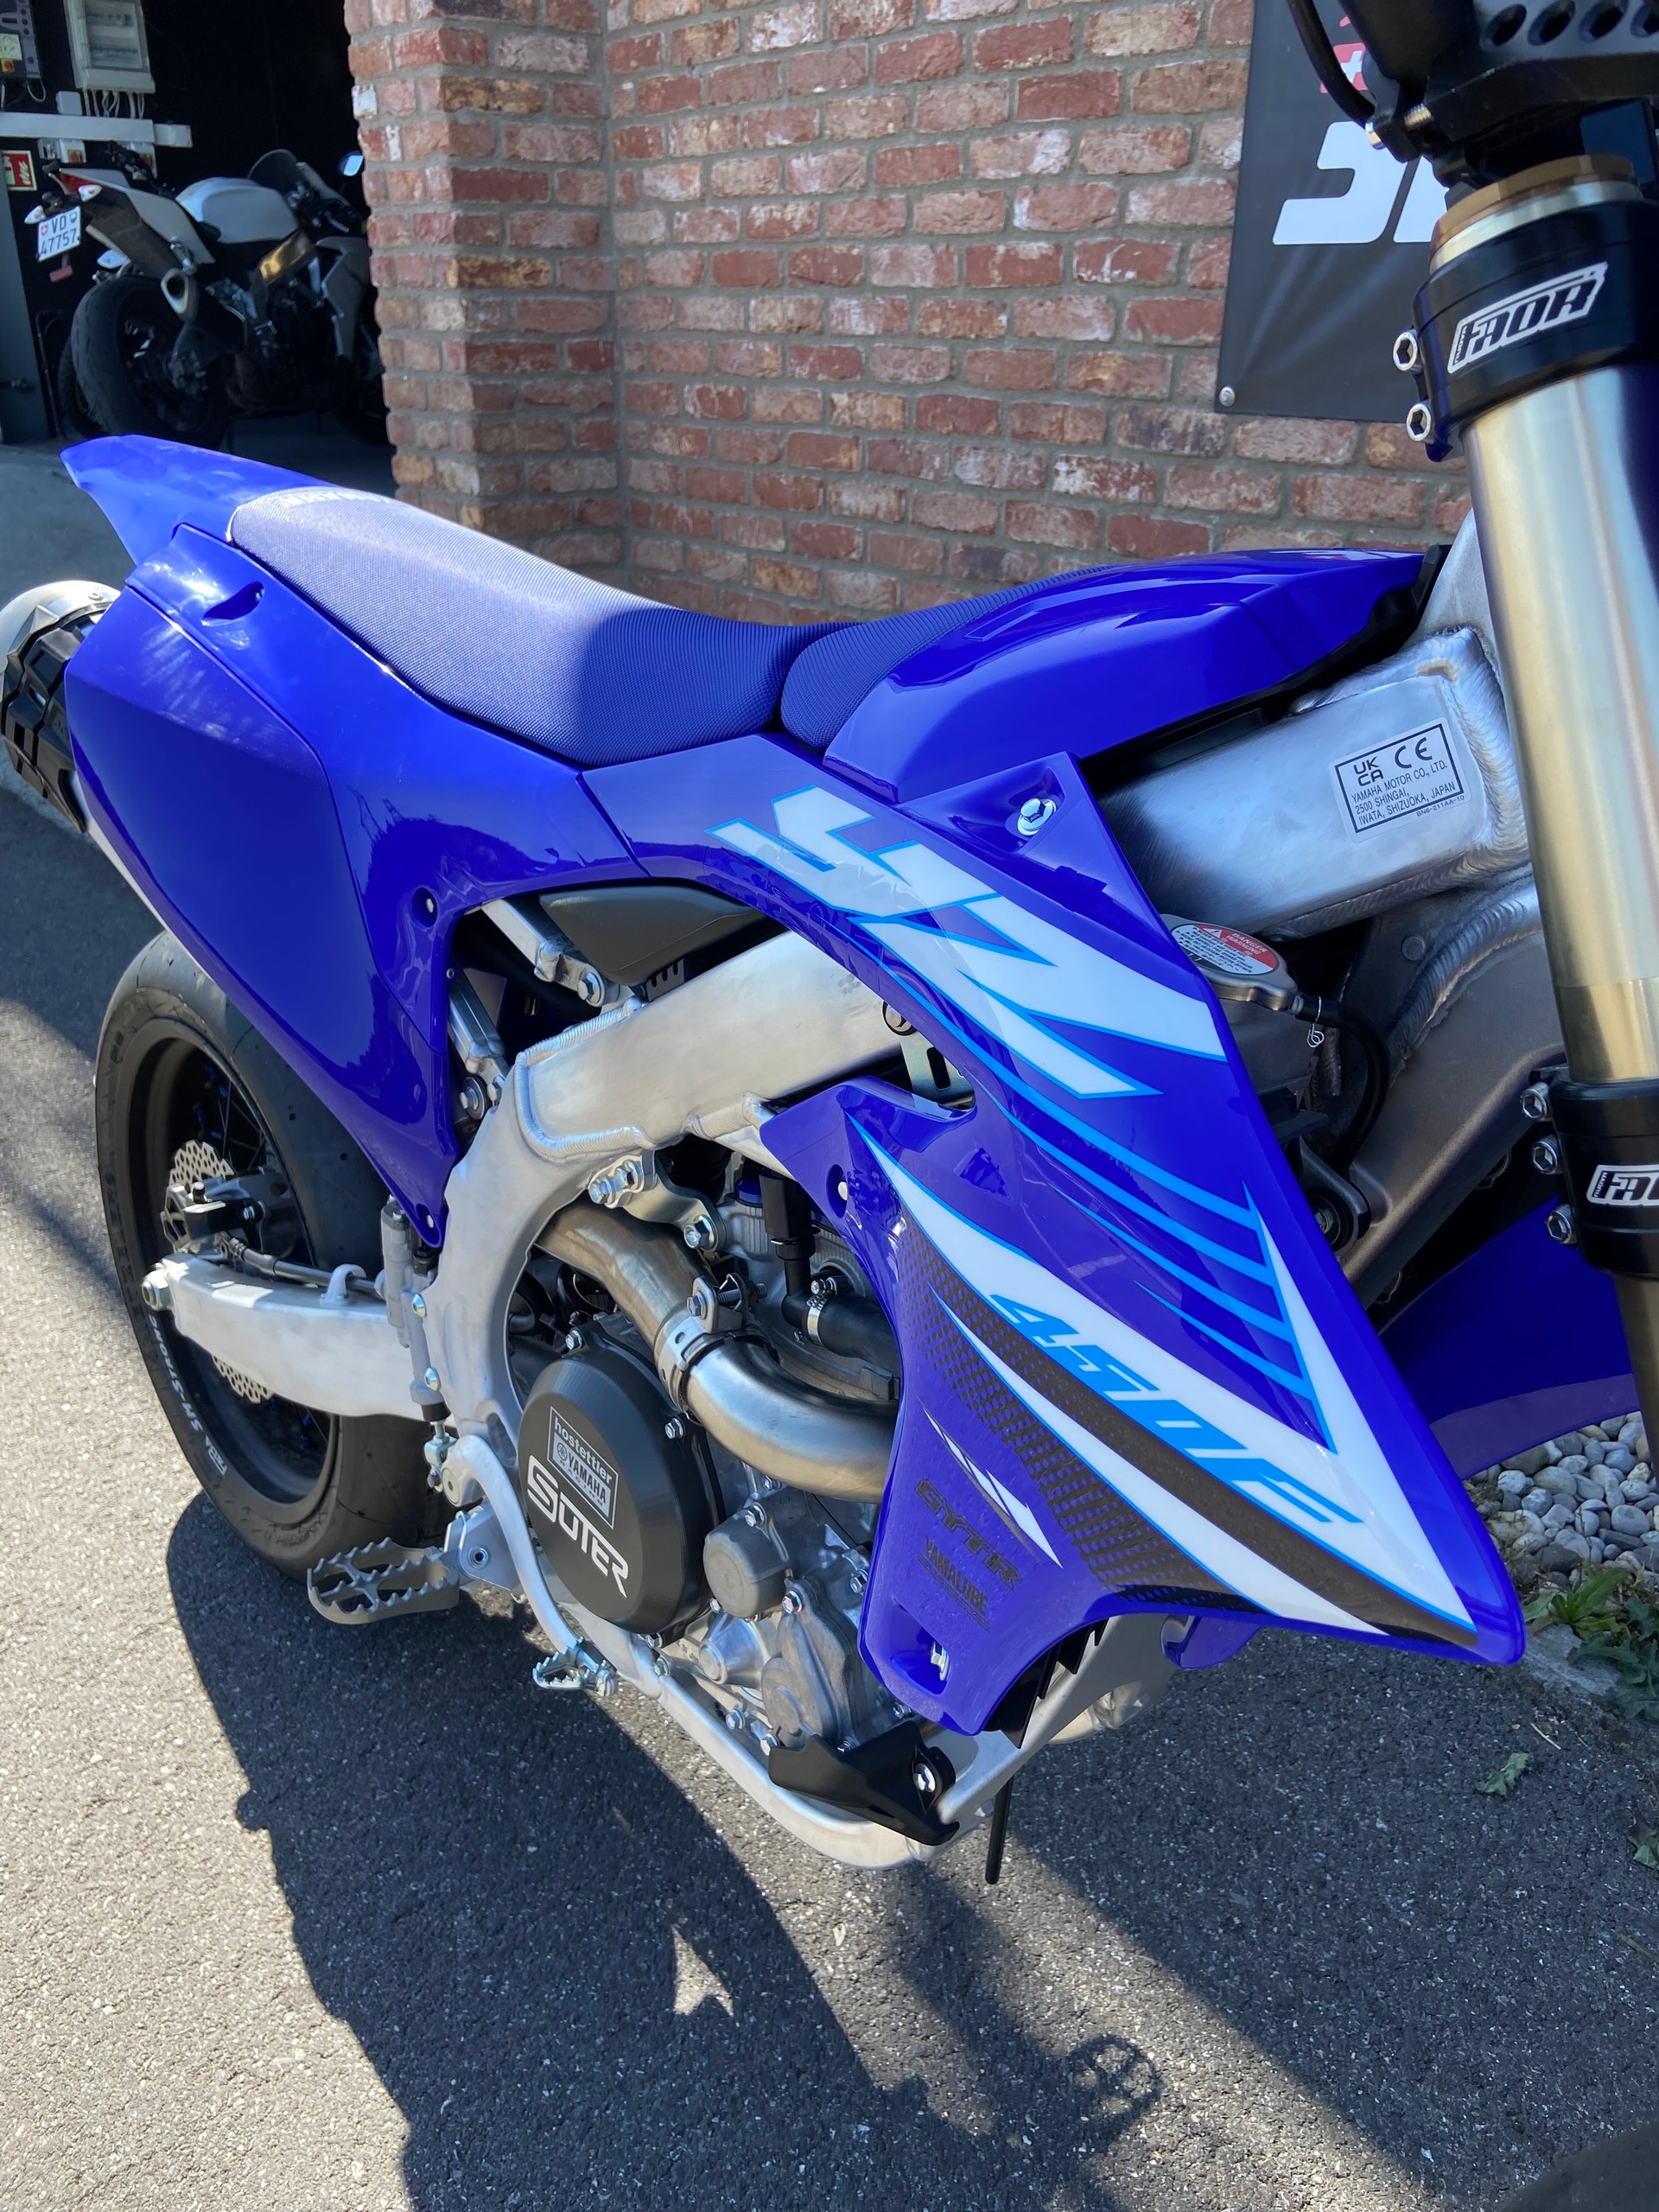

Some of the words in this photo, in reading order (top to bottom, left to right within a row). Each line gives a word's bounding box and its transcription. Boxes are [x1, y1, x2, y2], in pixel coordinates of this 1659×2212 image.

[40, 227, 77, 255] 47757
[51, 214, 67, 234] VD
[1353, 756, 1380, 775] UK
[1394, 736, 1433, 768] CE
[1351, 784, 1382, 804] YAMAHA
[1383, 772, 1412, 791] MOTOR
[1430, 760, 1448, 774] LTD.
[1357, 769, 1384, 786] CA
[1355, 800, 1373, 815] 2500
[1374, 787, 1410, 808] SHINGAI,
[1357, 810, 1385, 826] IWATA,
[1386, 792, 1429, 816] SHIZUOKA,
[1430, 780, 1456, 799] JAPAN
[1230, 932, 1268, 953] DANGER
[554, 1416, 613, 1485] hostettler
[567, 1452, 607, 1504] YAMAHA
[914, 1478, 1023, 1591] GYTR
